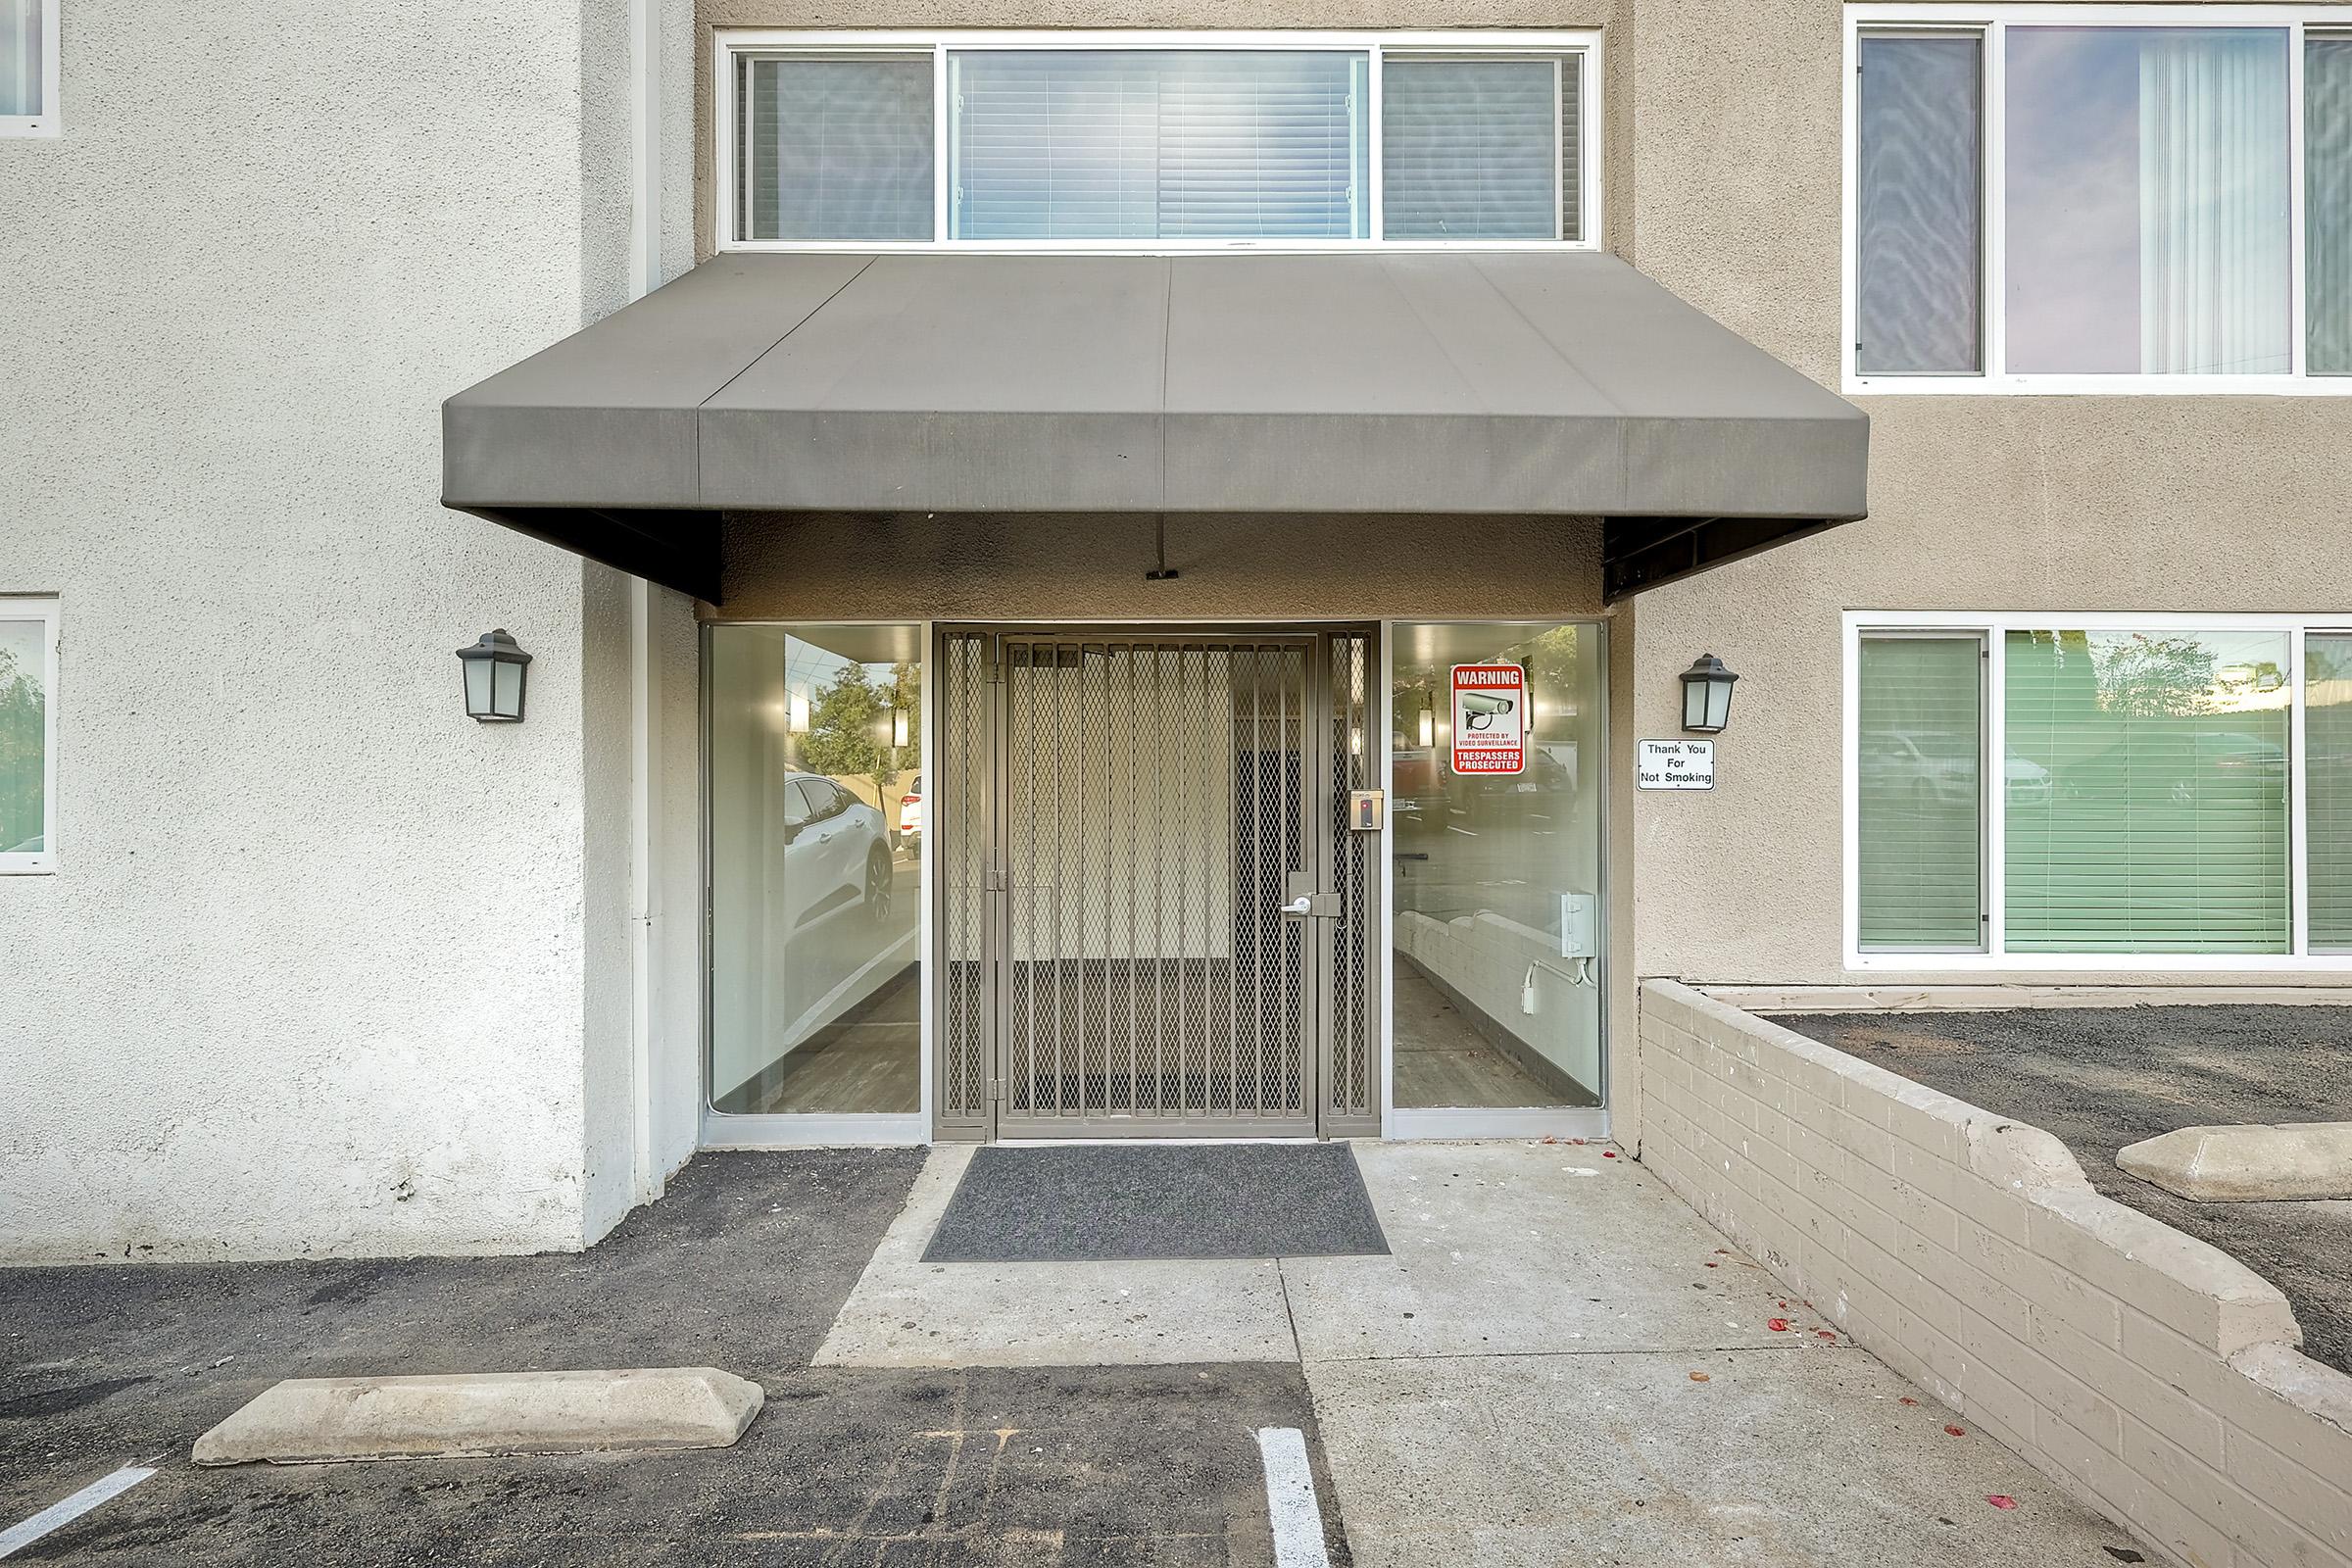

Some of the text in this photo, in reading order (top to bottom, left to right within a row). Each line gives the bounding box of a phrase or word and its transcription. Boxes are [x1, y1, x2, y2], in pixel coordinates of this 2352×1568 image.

[1456, 670, 1520, 685] WARNING
[1647, 744, 1706, 754] Thank You
[1457, 752, 1520, 760] TRESPASSERS
[1459, 760, 1518, 769] PROSECUTED
[1667, 759, 1686, 768] For
[1641, 772, 1712, 784] Not Smoking
